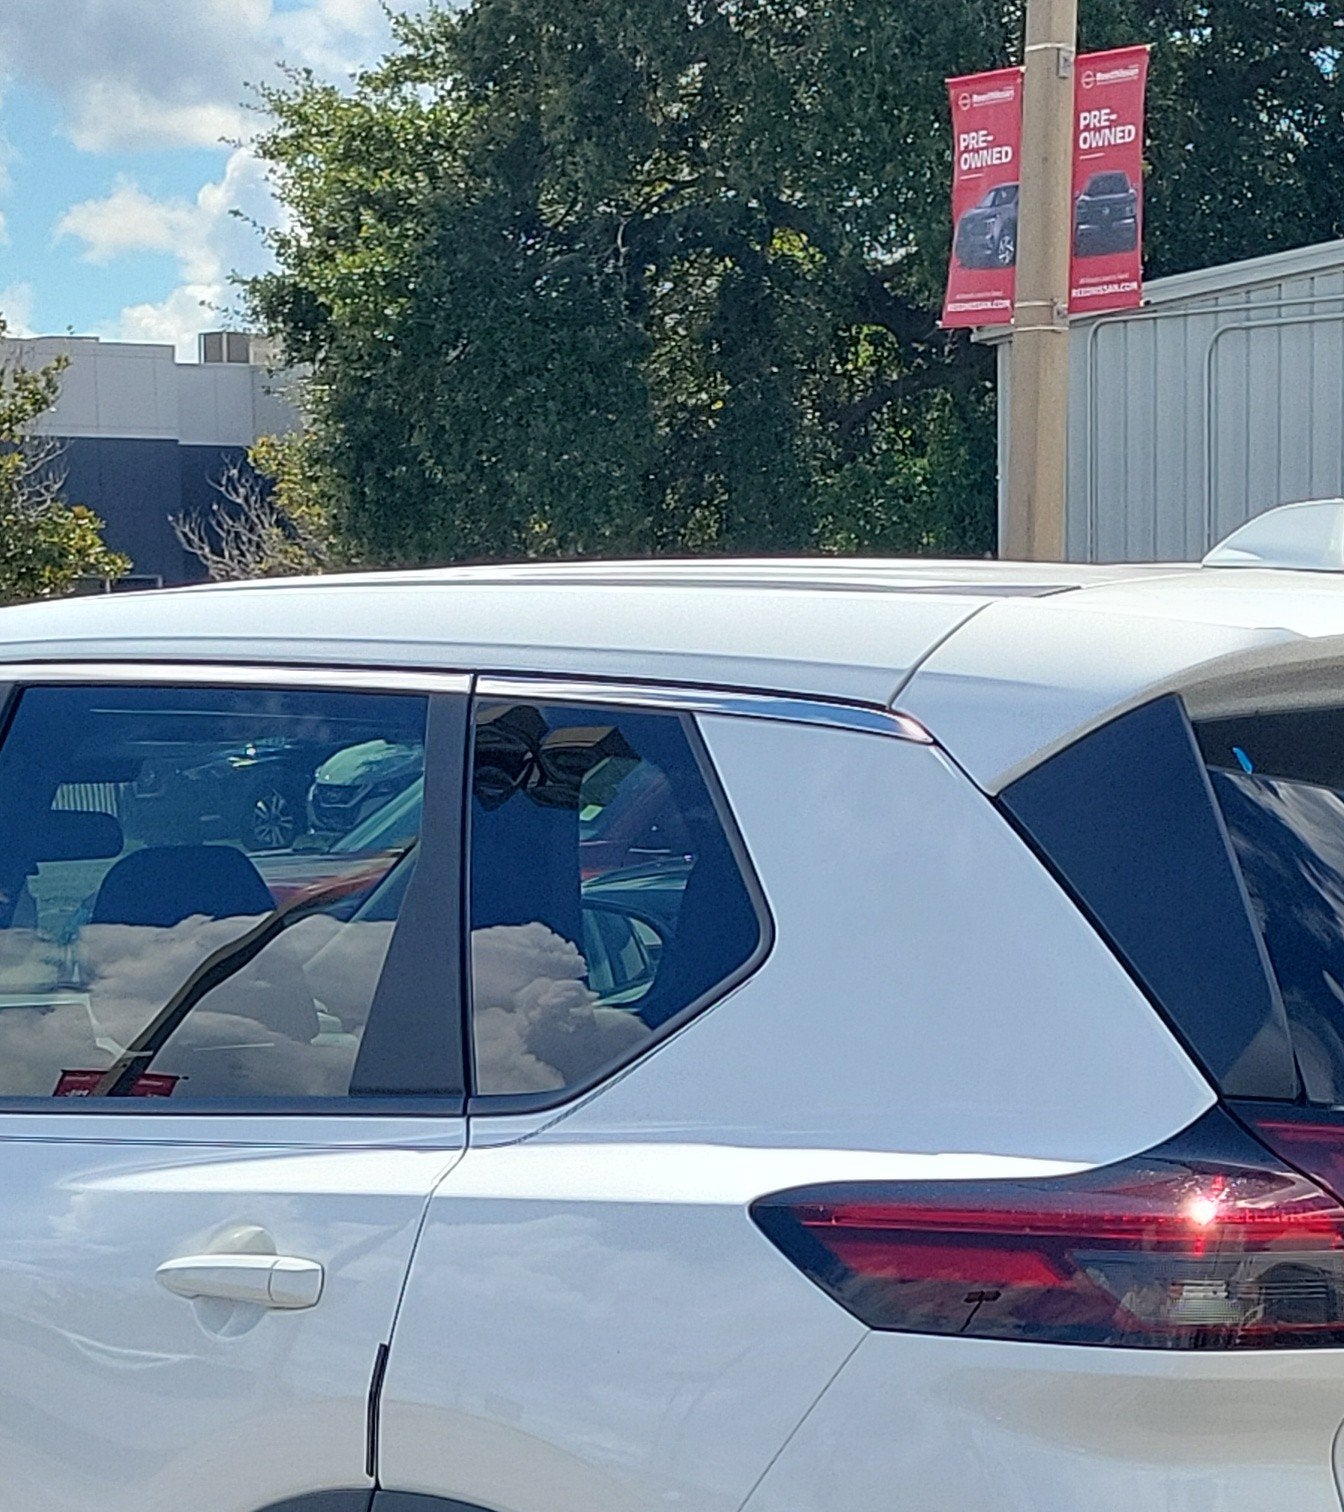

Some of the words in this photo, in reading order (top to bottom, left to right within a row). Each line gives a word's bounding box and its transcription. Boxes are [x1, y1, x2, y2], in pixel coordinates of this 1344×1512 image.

[1079, 108, 1117, 129] PRE-
[959, 130, 994, 150] PRE-
[1078, 124, 1136, 150] OWNED
[960, 145, 1013, 170] OWNED
